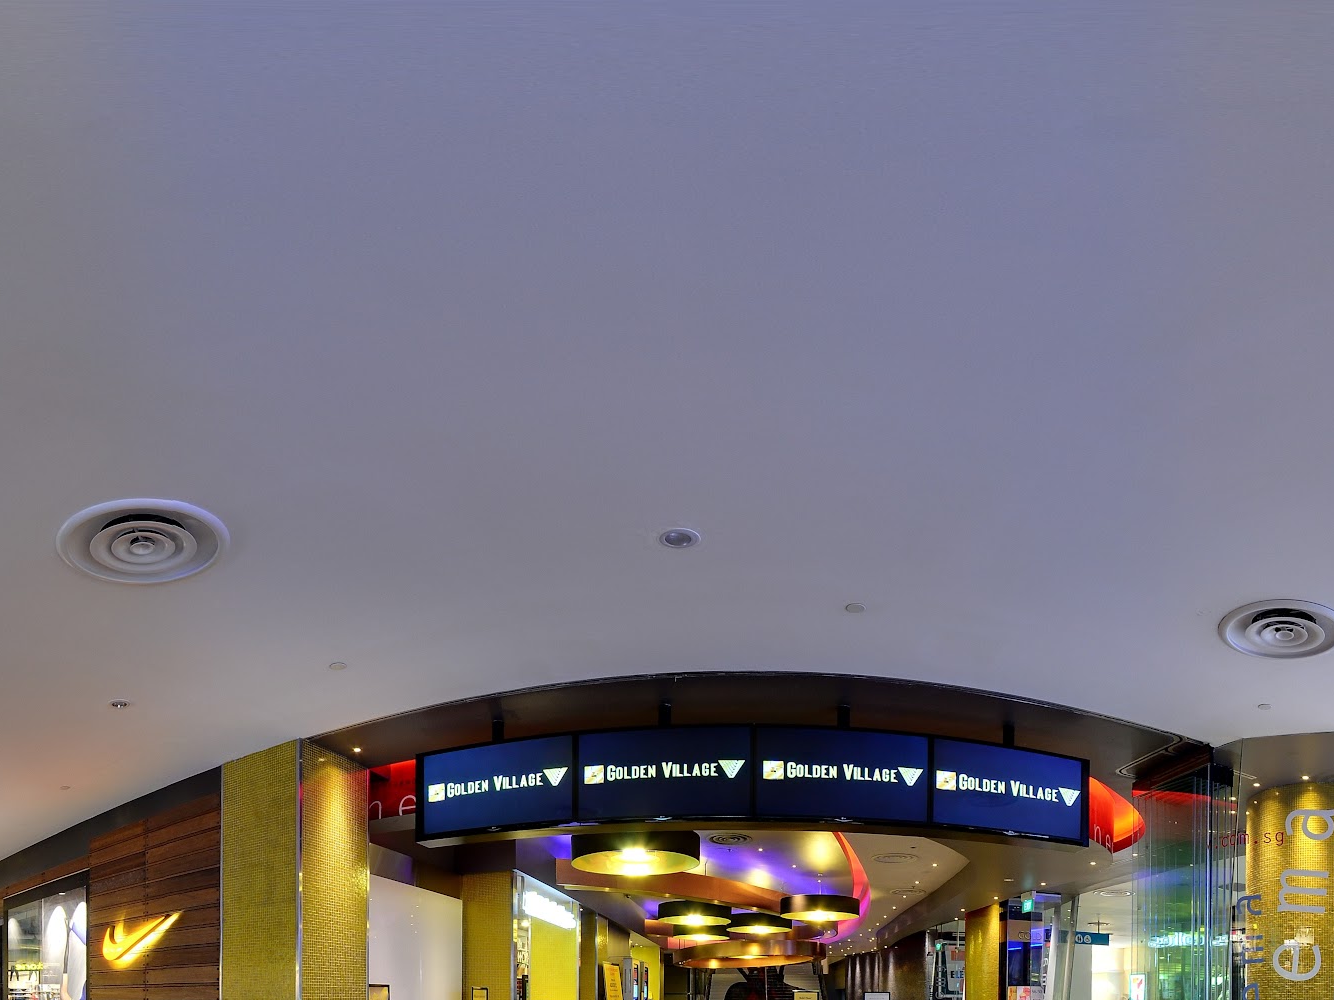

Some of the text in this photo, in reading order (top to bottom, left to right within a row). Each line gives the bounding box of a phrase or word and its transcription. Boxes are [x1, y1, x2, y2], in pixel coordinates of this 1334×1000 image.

[606, 761, 719, 782] GOLDEN VILLAGE
[786, 761, 899, 783] GOLDEN VILLAGE
[446, 772, 544, 799] GOLDEN VILLAGE
[958, 773, 1060, 803] GOLDEN VILLAGE
